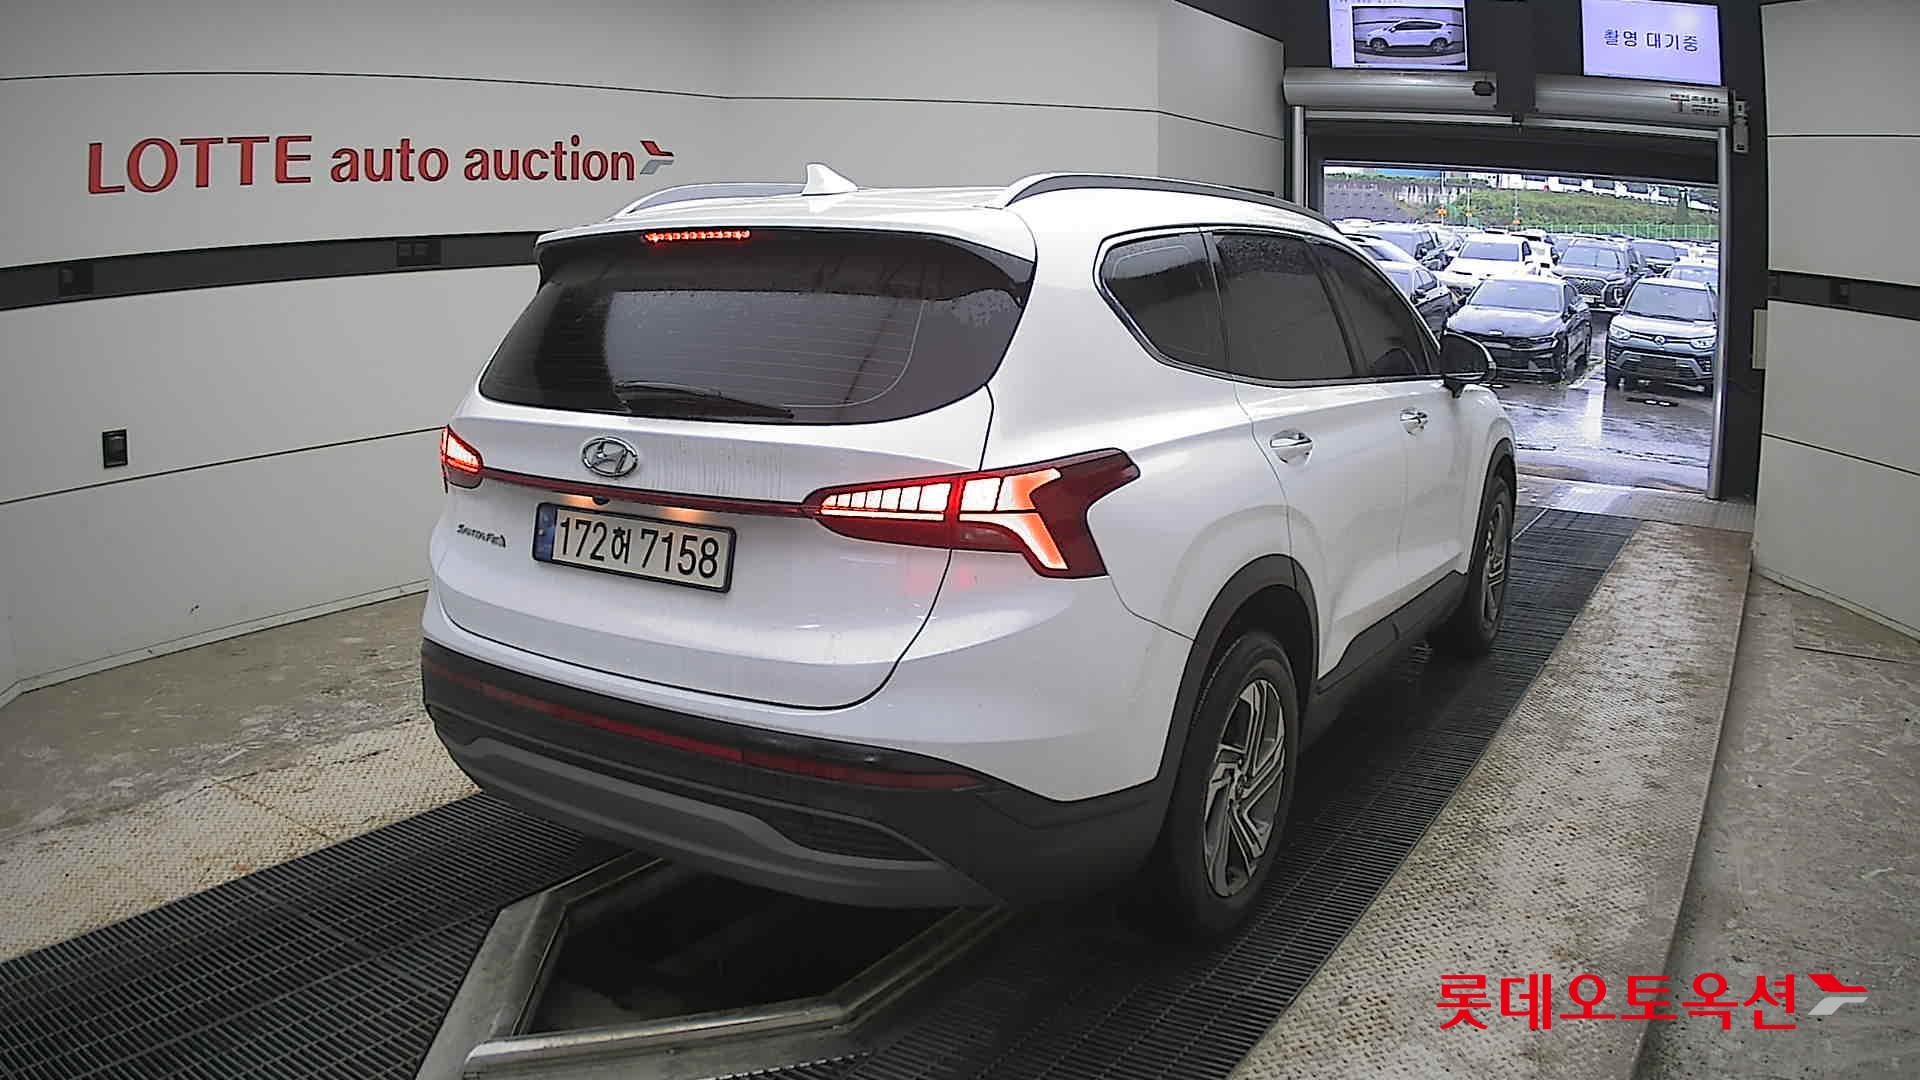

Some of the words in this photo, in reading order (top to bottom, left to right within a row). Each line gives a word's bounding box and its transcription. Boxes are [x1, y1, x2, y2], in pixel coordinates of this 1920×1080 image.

[1604, 29, 1638, 48] 촬영
[1646, 32, 1698, 53] 대기중
[88, 135, 312, 195] LOTTE
[330, 138, 449, 183] auto
[463, 135, 635, 182] auction
[560, 516, 632, 564] 172허
[640, 528, 720, 579] 7158
